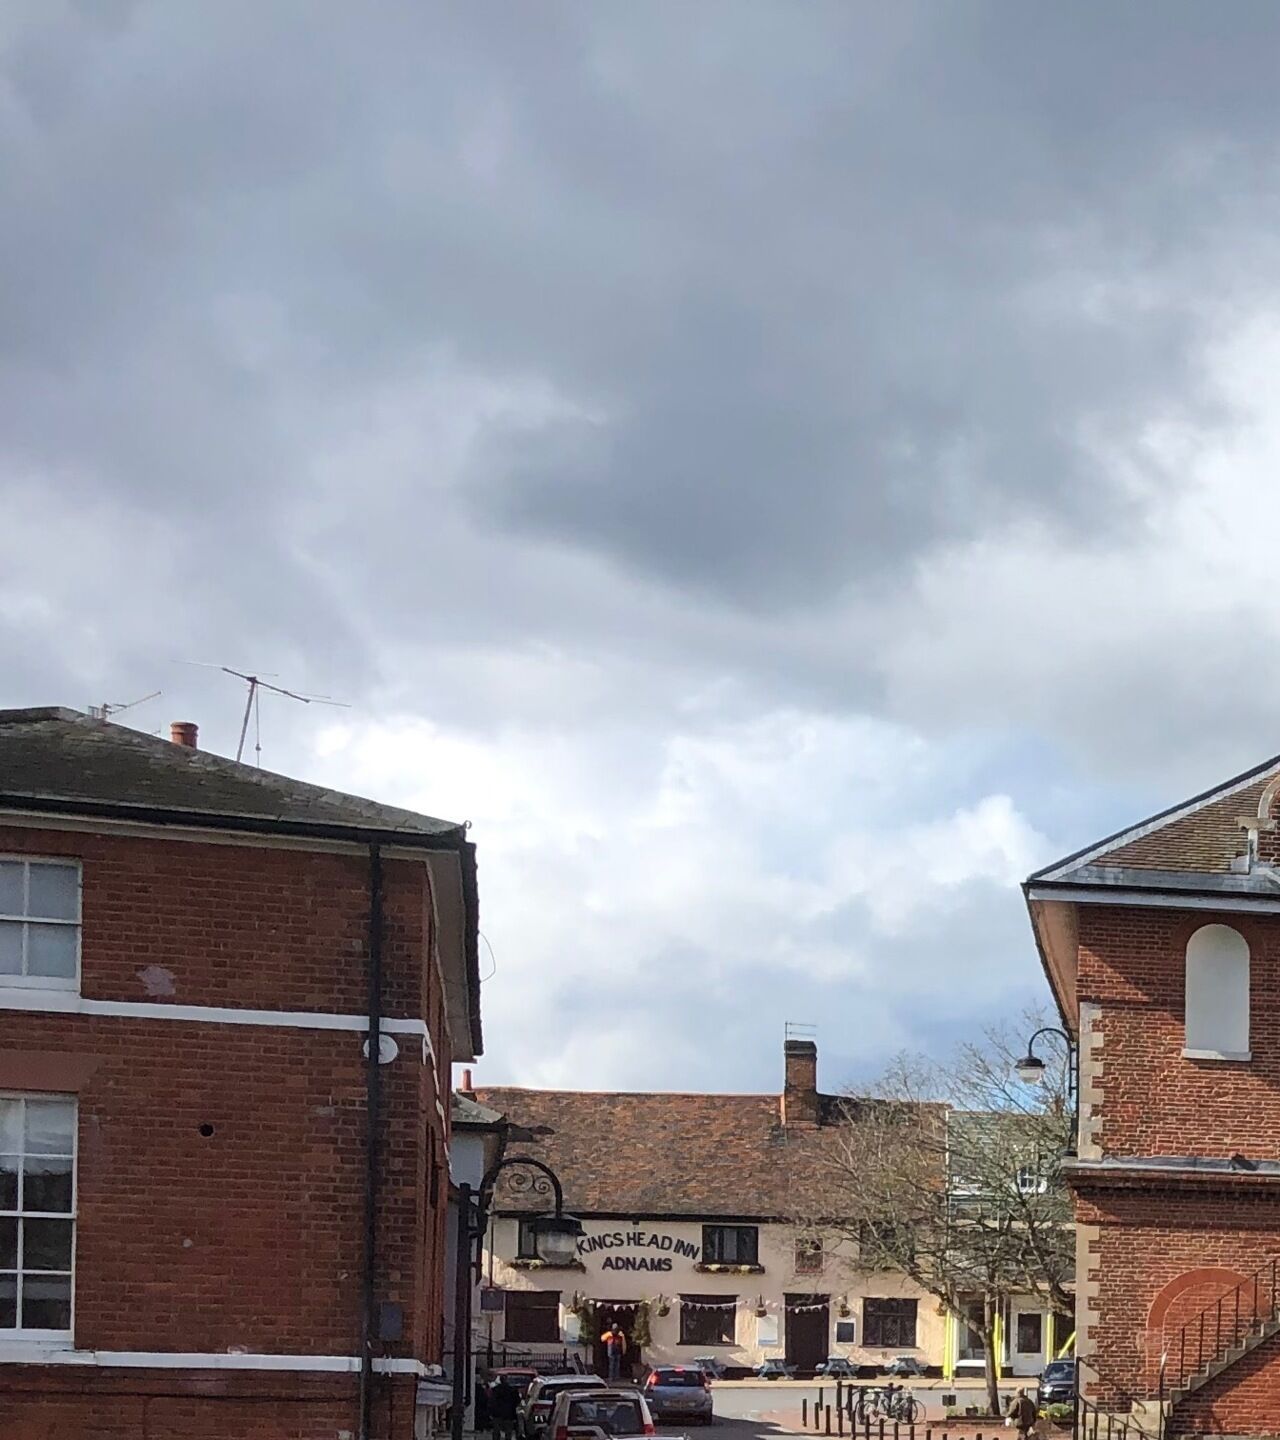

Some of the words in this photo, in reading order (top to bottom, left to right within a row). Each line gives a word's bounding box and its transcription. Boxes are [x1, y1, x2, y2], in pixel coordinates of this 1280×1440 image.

[576, 1232, 624, 1255] KINGS
[626, 1231, 673, 1250] HEAD
[673, 1238, 699, 1260] INN
[602, 1256, 673, 1272] ADNAMS
